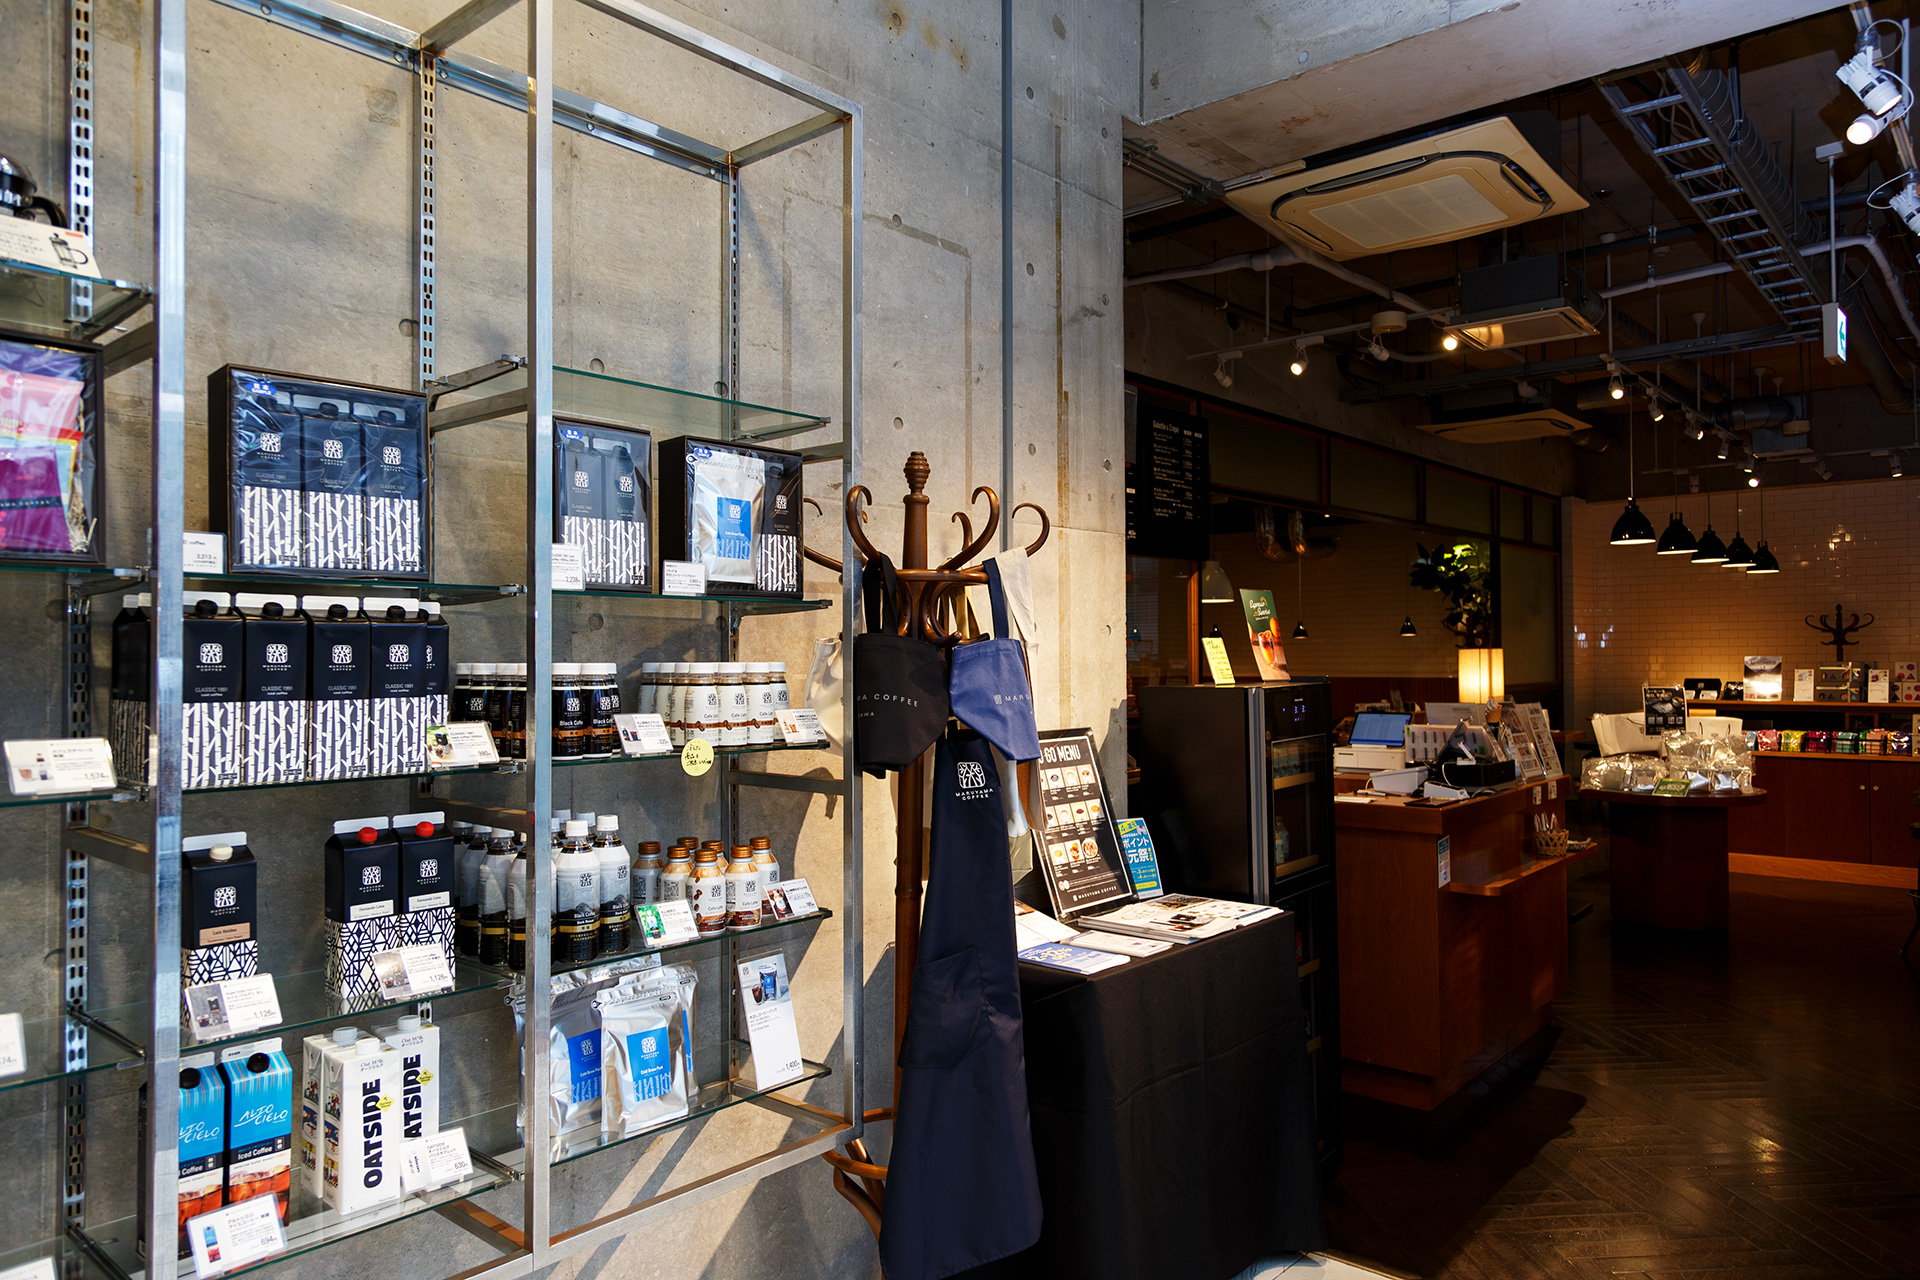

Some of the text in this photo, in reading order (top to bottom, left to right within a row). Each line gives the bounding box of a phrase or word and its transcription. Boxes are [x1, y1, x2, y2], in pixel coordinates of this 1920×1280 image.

[873, 693, 918, 708] COFFEE
[1044, 744, 1081, 763] GO MENU
[955, 788, 994, 797] MARUYAMA
[1123, 836, 1149, 848] ポイント
[1078, 890, 1100, 899] MARUYAMA
[403, 1054, 422, 1138] ATSIDE
[255, 1110, 288, 1125] CIELO
[180, 1122, 205, 1135] LTO
[185, 1127, 220, 1143] CIELO
[362, 1079, 383, 1188] OATSIDE
[238, 1150, 252, 1160] Iced
[253, 1145, 273, 1156] Coffee
[182, 1165, 203, 1175] Coffee
